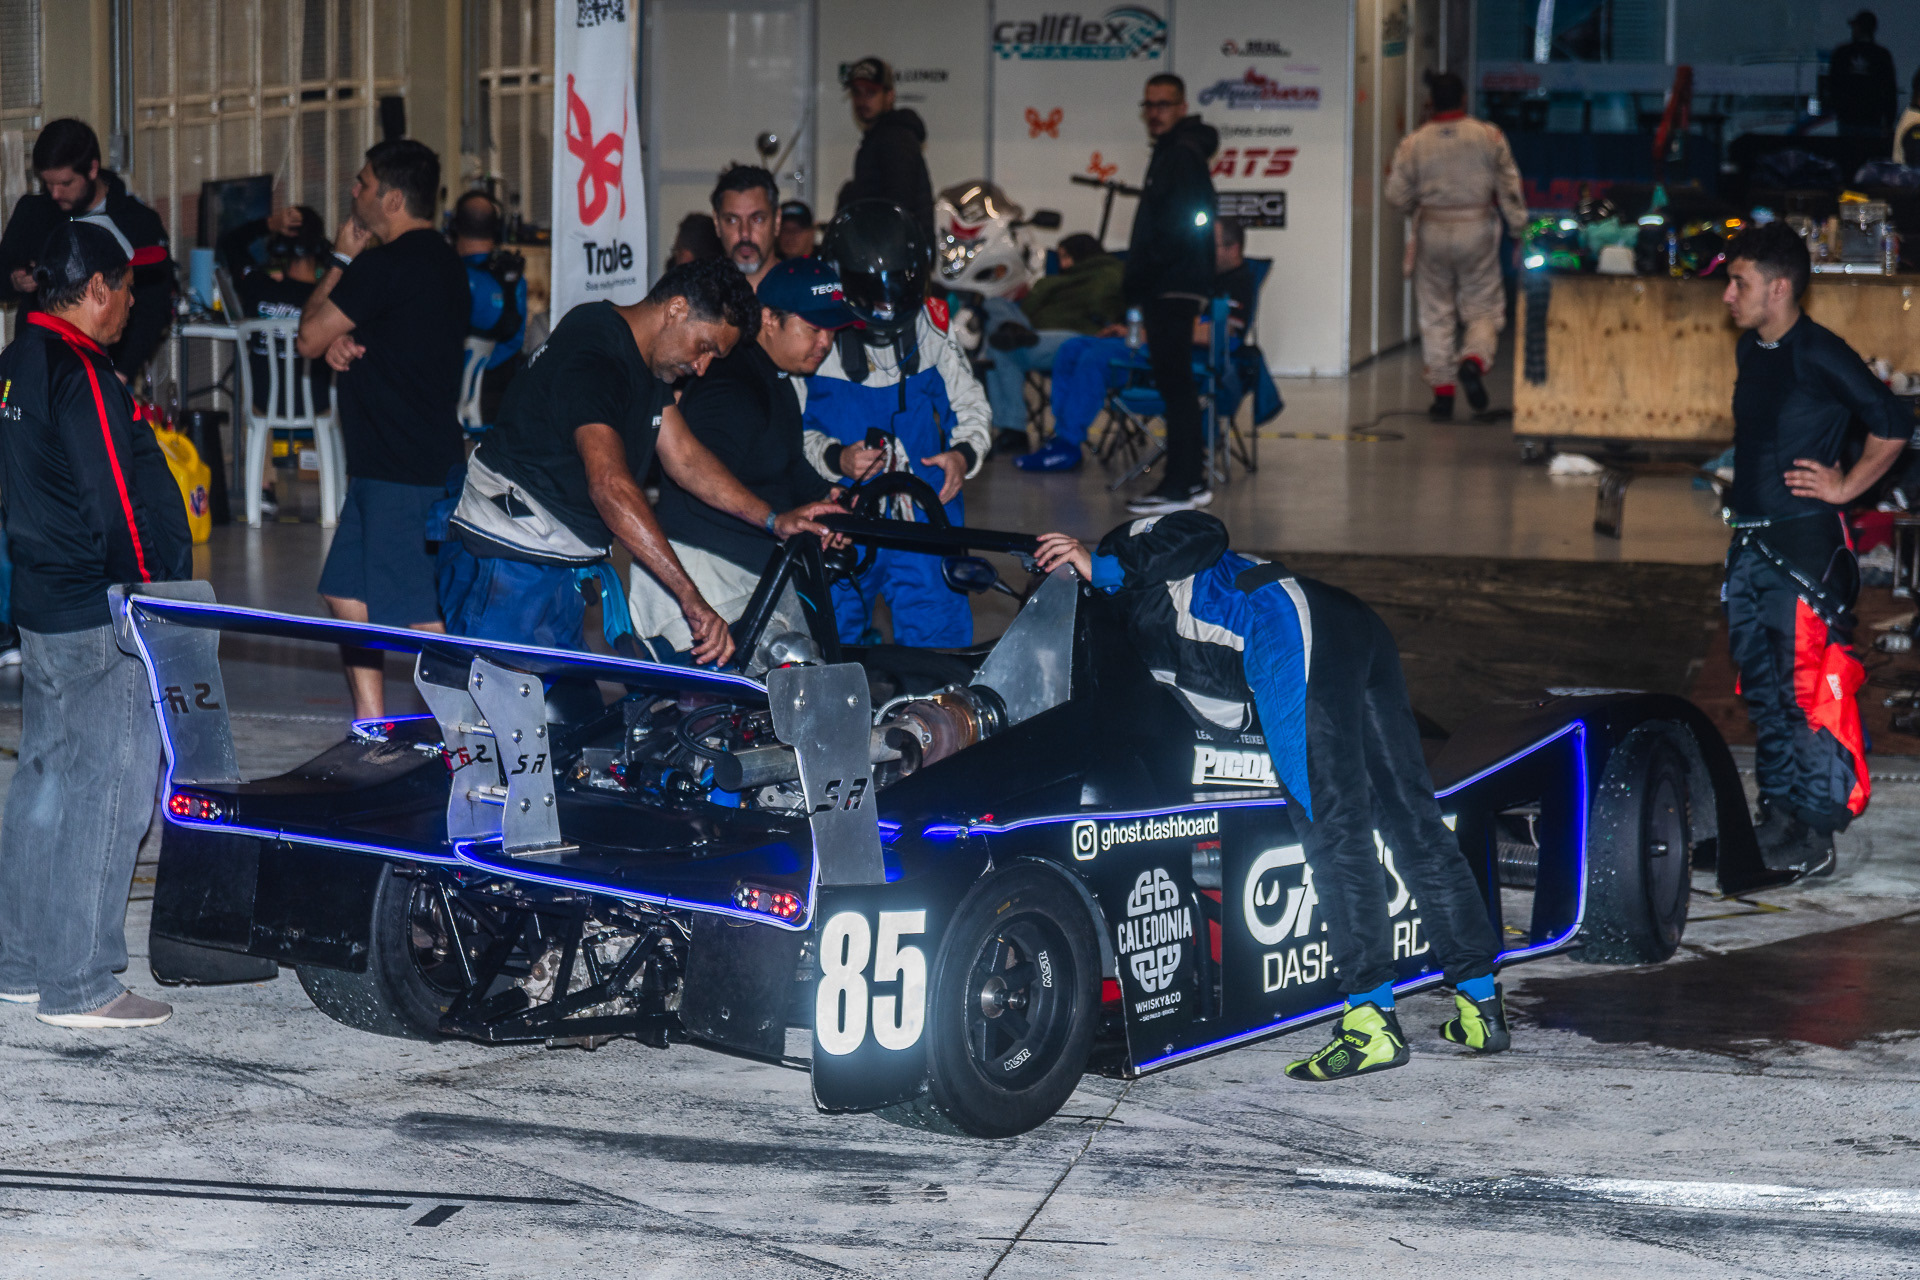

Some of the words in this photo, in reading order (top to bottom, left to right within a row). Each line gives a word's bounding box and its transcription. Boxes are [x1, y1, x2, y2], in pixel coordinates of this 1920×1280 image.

[993, 13, 1128, 45] callflex
[1101, 811, 1219, 851] ghost.dashboard
[1118, 907, 1193, 955] CALEDONIA
[816, 911, 927, 1056] 85
[1038, 951, 1052, 987] MSR
[1135, 991, 1182, 1014] WHISKY&CO
[1004, 1049, 1031, 1071] MSR
